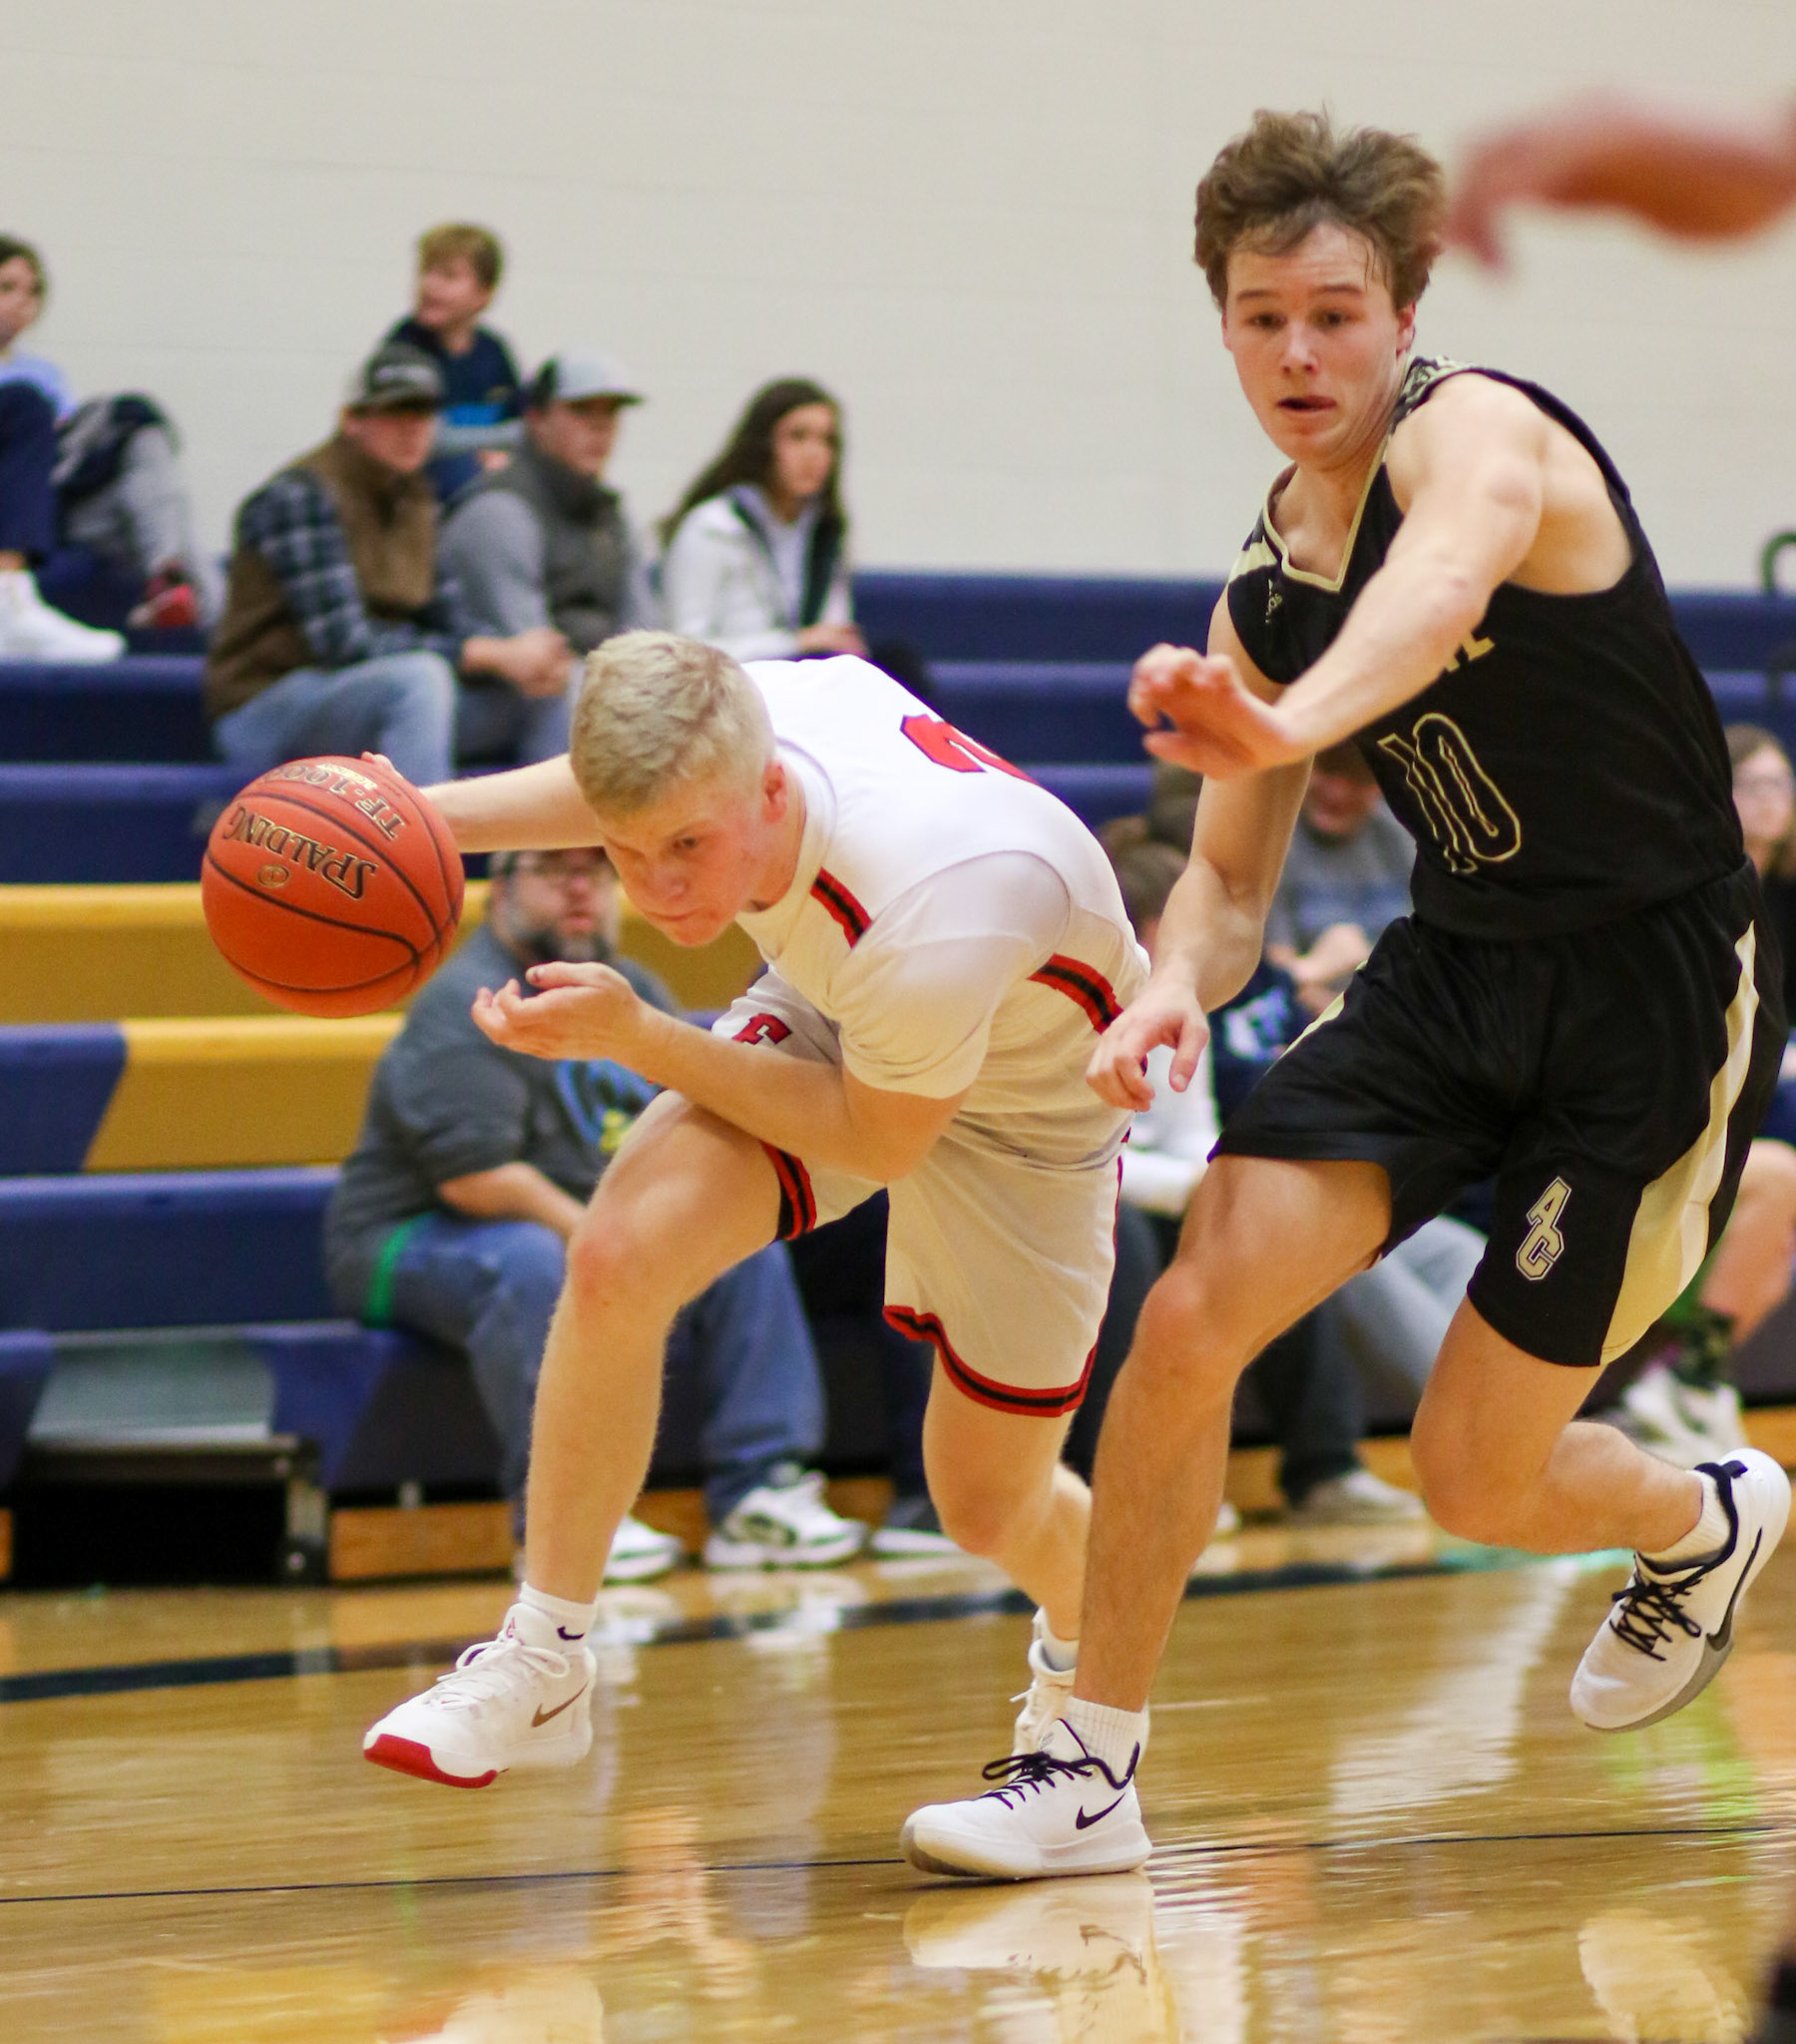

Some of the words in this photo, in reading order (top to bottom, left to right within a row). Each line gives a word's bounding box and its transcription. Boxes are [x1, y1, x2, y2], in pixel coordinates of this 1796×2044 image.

[1377, 712, 1522, 874] 10
[223, 804, 378, 901] SPALDING
[1516, 1176, 1572, 1281] AC
